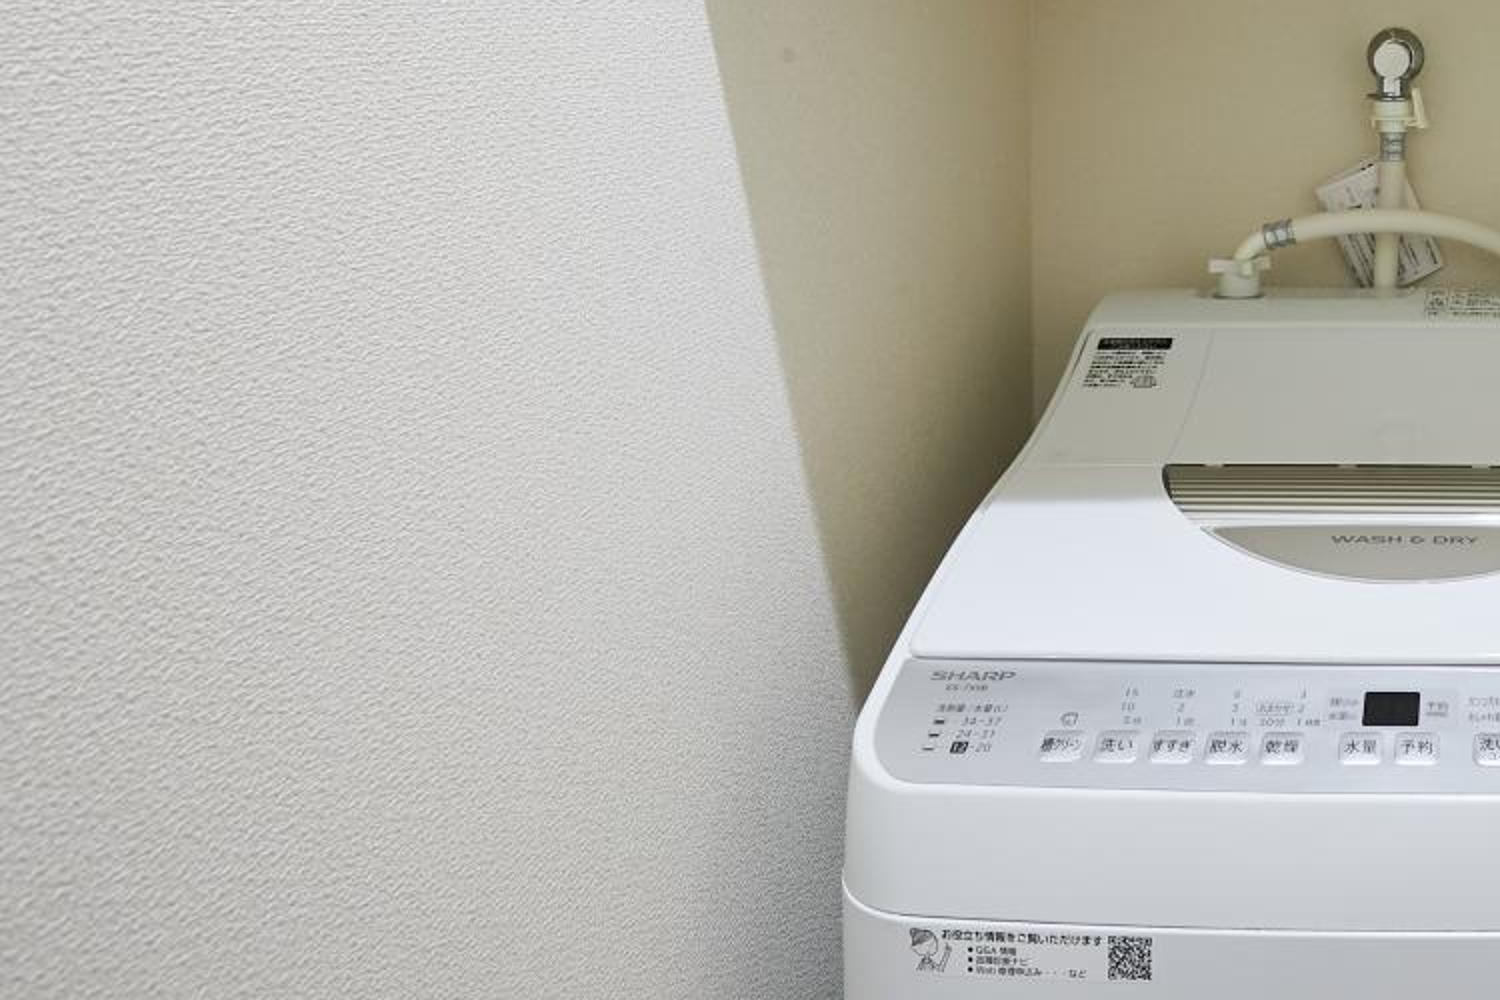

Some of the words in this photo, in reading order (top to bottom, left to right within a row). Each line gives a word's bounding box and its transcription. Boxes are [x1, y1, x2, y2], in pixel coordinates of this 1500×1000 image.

[1331, 535, 1401, 544] WASH
[1433, 535, 1478, 544] DRY
[930, 671, 1017, 681] SHARP
[1101, 738, 1134, 752] 洗い
[1153, 738, 1193, 752] すすぎ
[1209, 739, 1244, 754] 脱水
[1344, 739, 1377, 754] 水量
[1401, 739, 1434, 755] 予約
